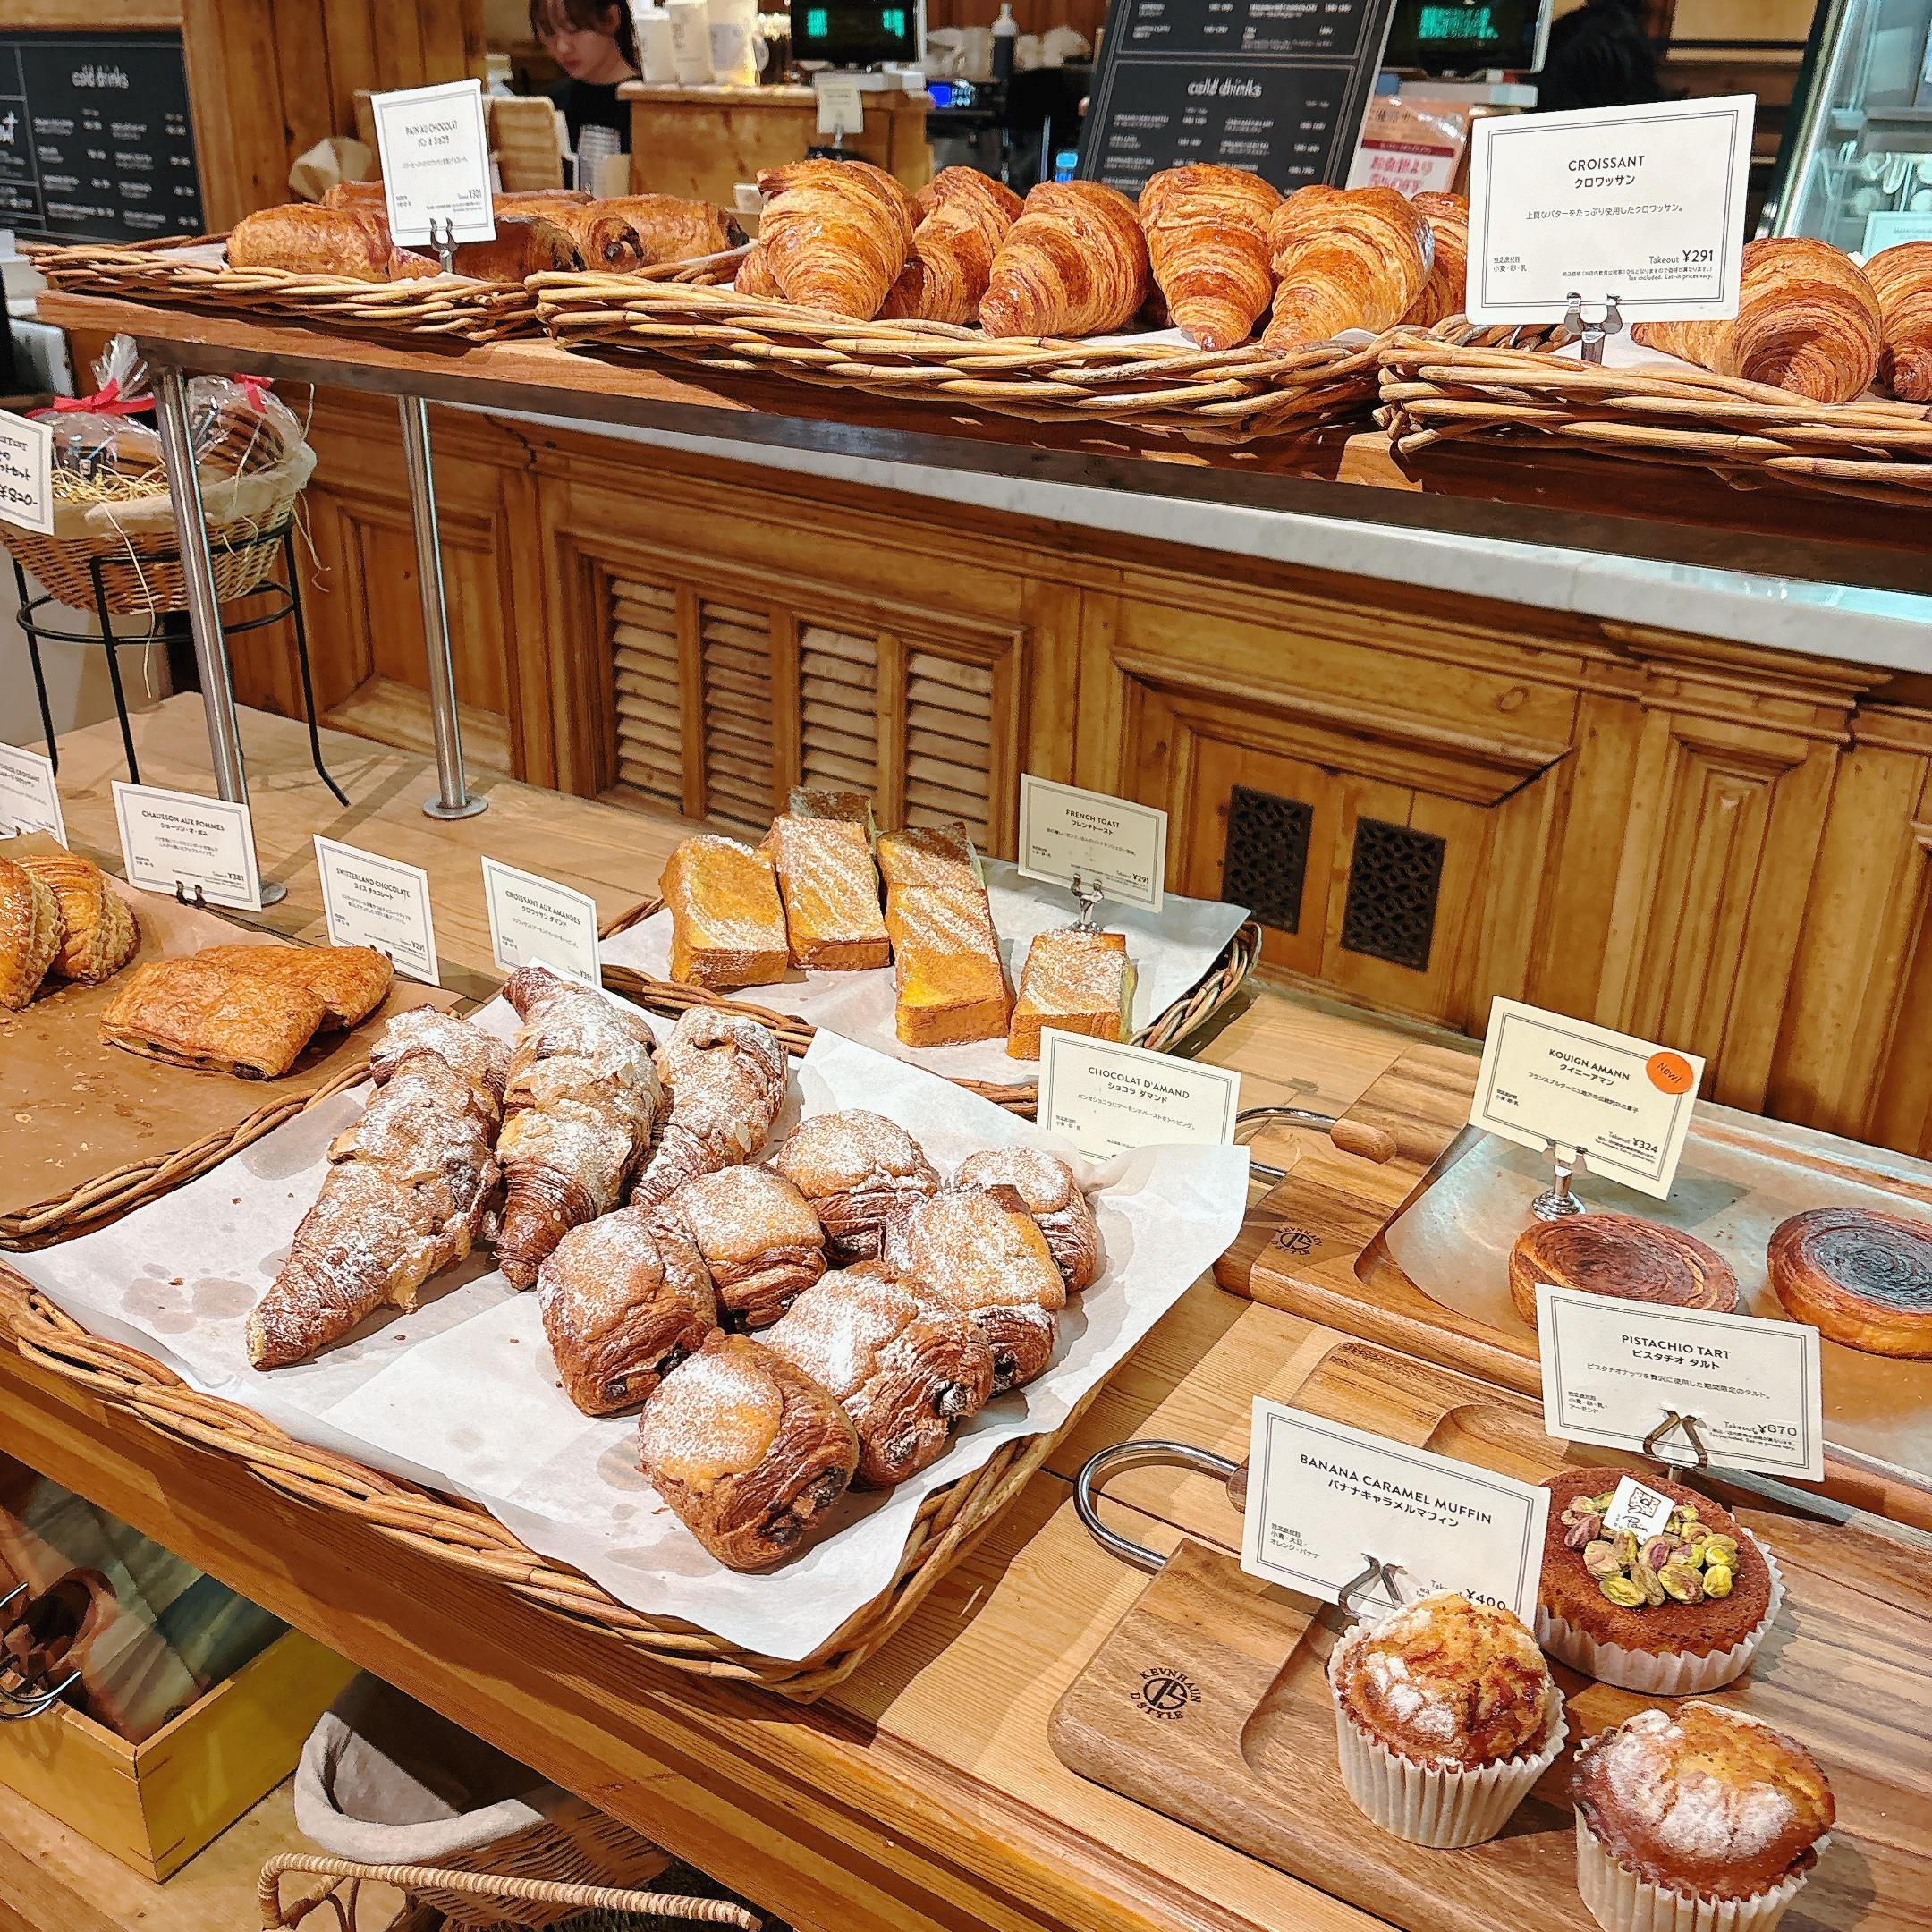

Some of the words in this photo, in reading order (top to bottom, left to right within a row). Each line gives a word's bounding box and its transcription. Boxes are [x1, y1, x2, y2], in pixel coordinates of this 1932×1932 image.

[1188, 77, 1219, 97] cold
[1219, 77, 1262, 97] drinks
[1568, 156, 1645, 172] CROISSANT
[1574, 174, 1636, 189] クロワッサン
[1649, 255, 1679, 264] Takeout
[1682, 250, 1714, 262] ¥291
[141, 810, 179, 823] CHAUSSON
[181, 816, 195, 826] AUX
[196, 819, 225, 832] POMMES
[1065, 809, 1097, 823] FRENCH
[1097, 817, 1120, 828] TOAST
[1072, 820, 1114, 835] フレンチトースト
[336, 867, 374, 886] SWITZERLAND
[376, 880, 411, 898] CHOCOLATE
[1132, 873, 1149, 885] ¥291
[505, 890, 538, 908] CROISSANT
[539, 903, 552, 913] AUX
[553, 908, 580, 925] AMANDES
[1549, 1048, 1591, 1068] KOUIGN
[1590, 1063, 1631, 1080] AMANN
[1088, 1066, 1141, 1086] CHOCOLAT
[1144, 1080, 1190, 1099] D'AMAND
[1559, 1063, 1614, 1087] クイニーアマン
[1107, 1082, 1136, 1095] ショコラ
[1140, 1089, 1168, 1103] ダマンド
[1633, 1137, 1657, 1153] ¥324
[1622, 1334, 1693, 1354] PISTACHIO
[1697, 1345, 1731, 1360] TART
[1632, 1348, 1684, 1365] ピスタチオ
[1689, 1357, 1721, 1371] タルト
[1757, 1424, 1797, 1436] ¥670
[1300, 1453, 1359, 1483] BANANA
[1362, 1476, 1431, 1505] CARAMEL
[1434, 1499, 1492, 1524] MUFFIN
[1328, 1479, 1459, 1528] バナナキャラメルマフィン
[1466, 1589, 1506, 1610] ¥400
